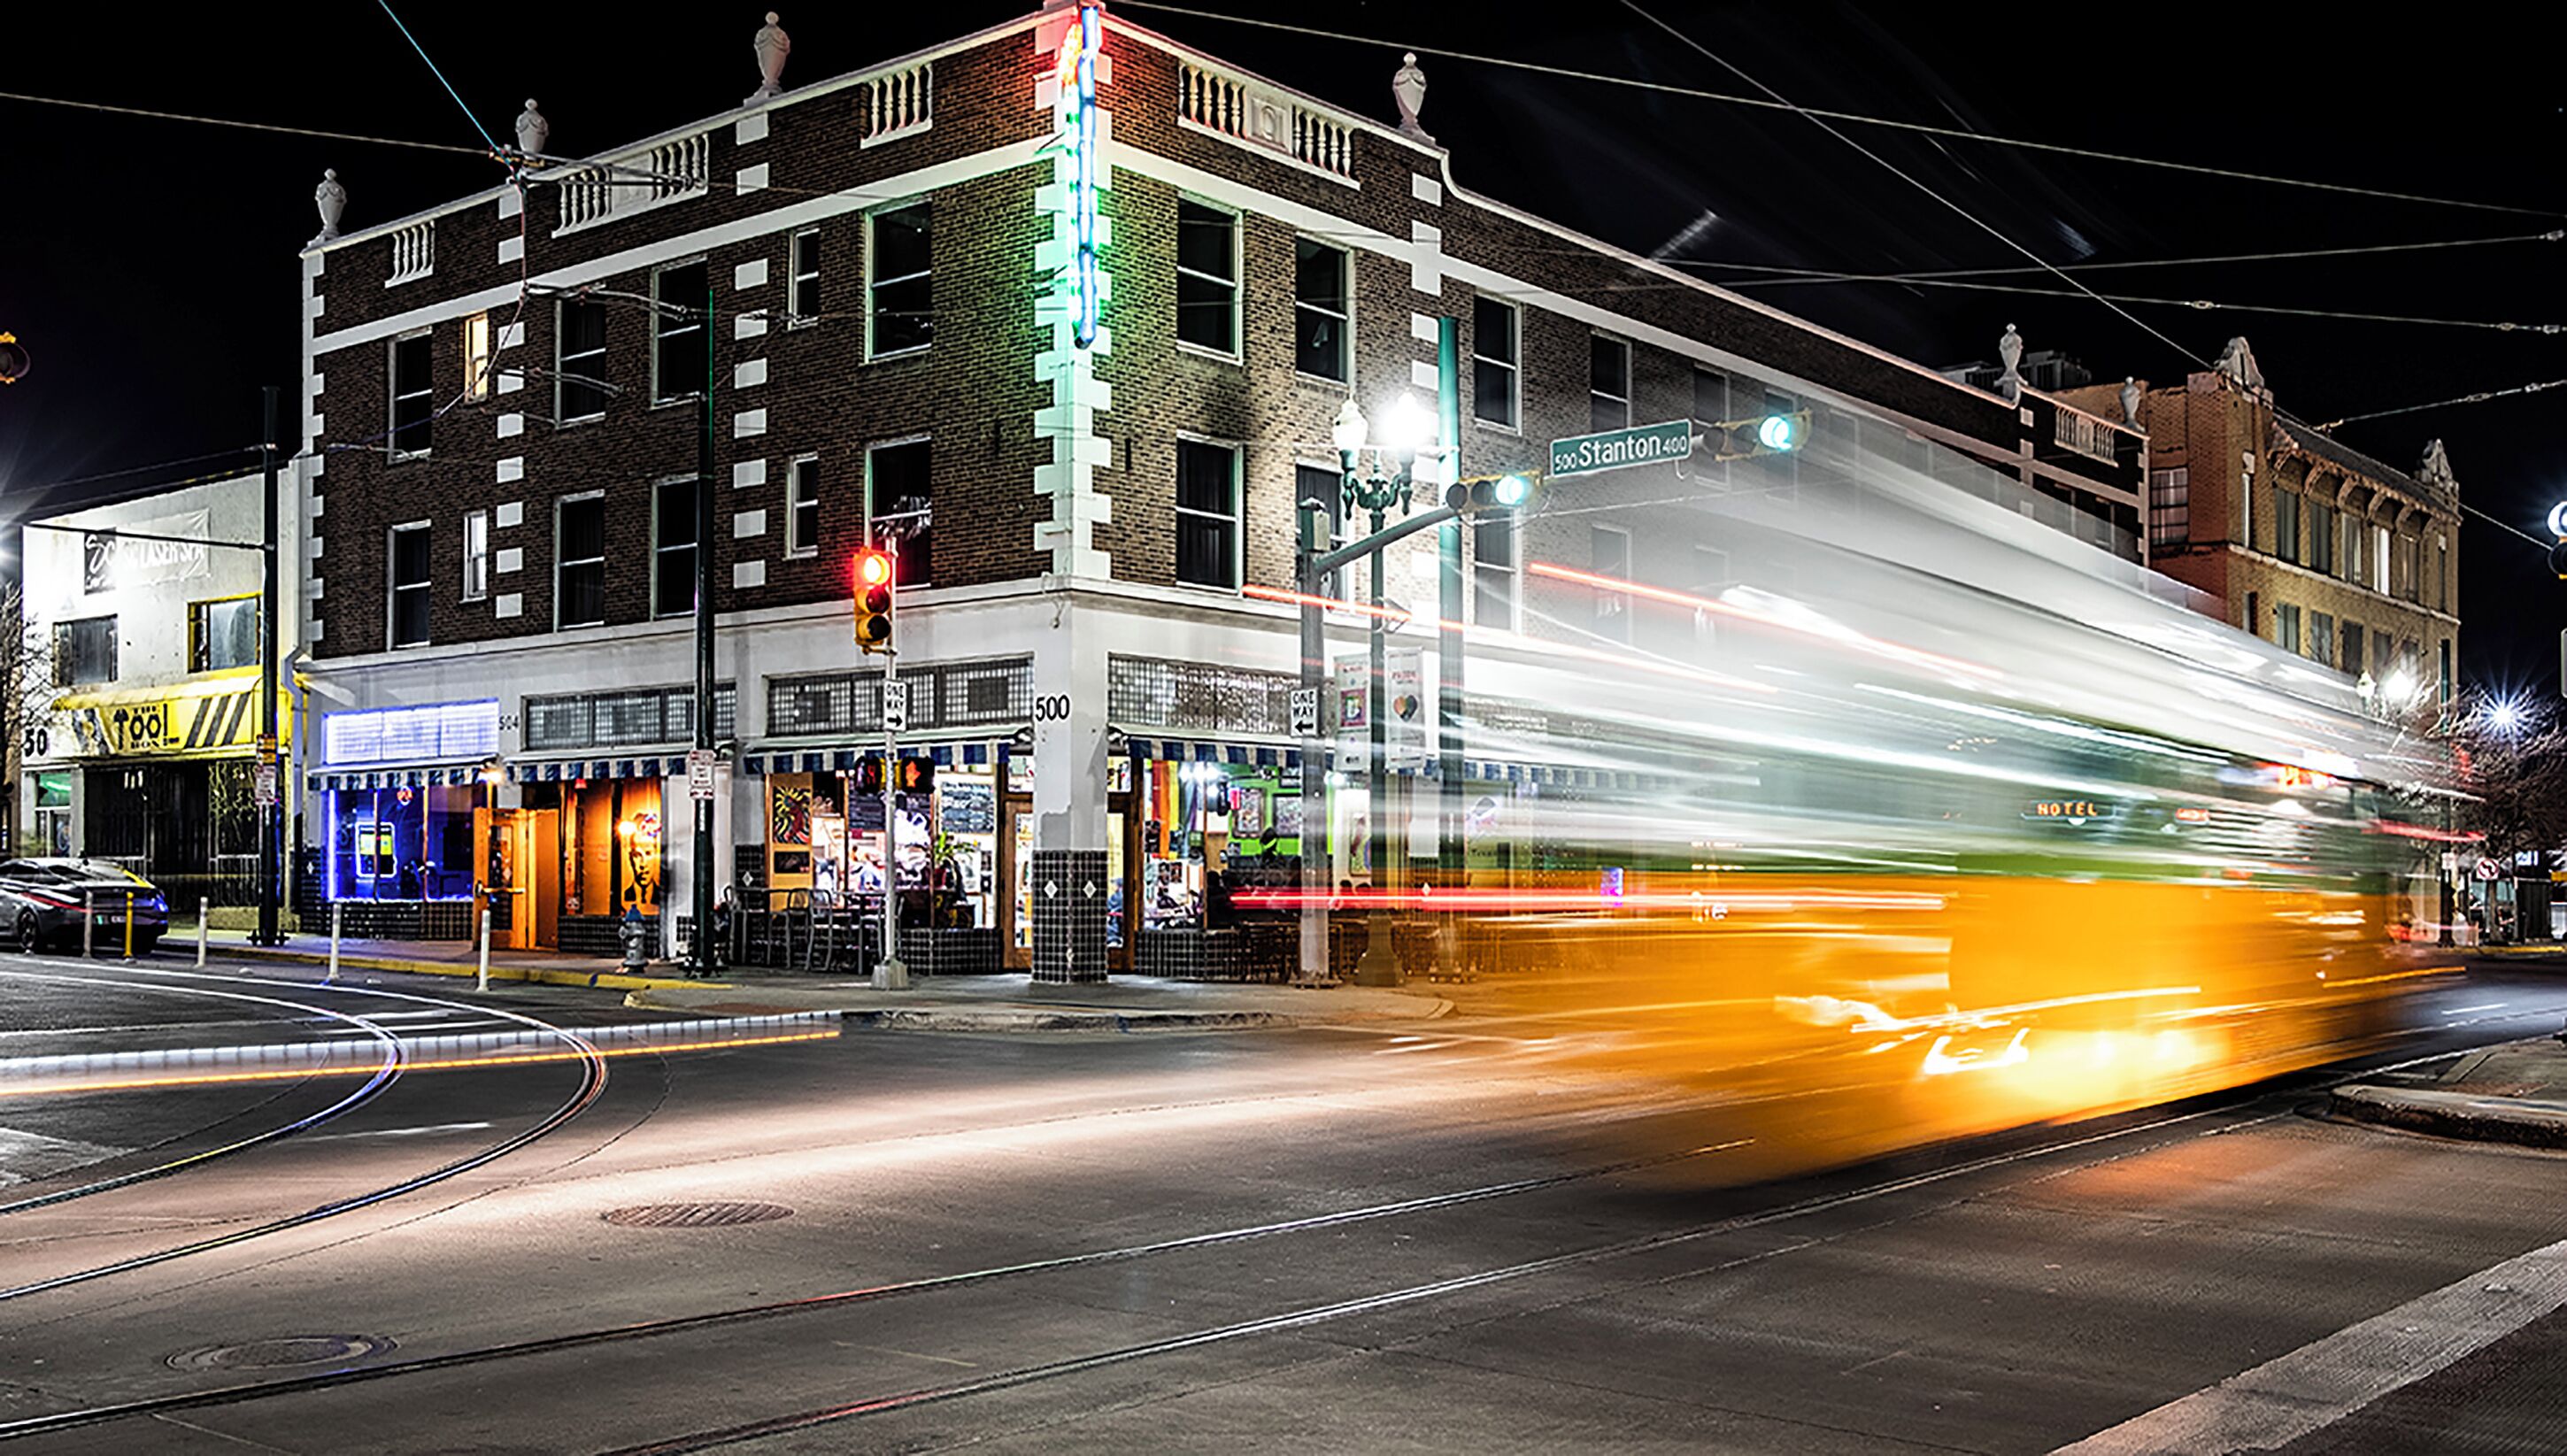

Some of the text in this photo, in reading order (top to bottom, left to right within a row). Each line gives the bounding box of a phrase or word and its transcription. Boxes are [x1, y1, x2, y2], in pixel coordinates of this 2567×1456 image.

[1555, 435, 1687, 472] 500 Stanton 400
[886, 682, 904, 697] ONE
[886, 699, 904, 710] WAY
[1293, 691, 1314, 705] ONE
[1035, 694, 1070, 722] 500
[1293, 706, 1314, 718] WAY
[498, 715, 519, 731] 504
[2037, 801, 2098, 817] HOTEL
